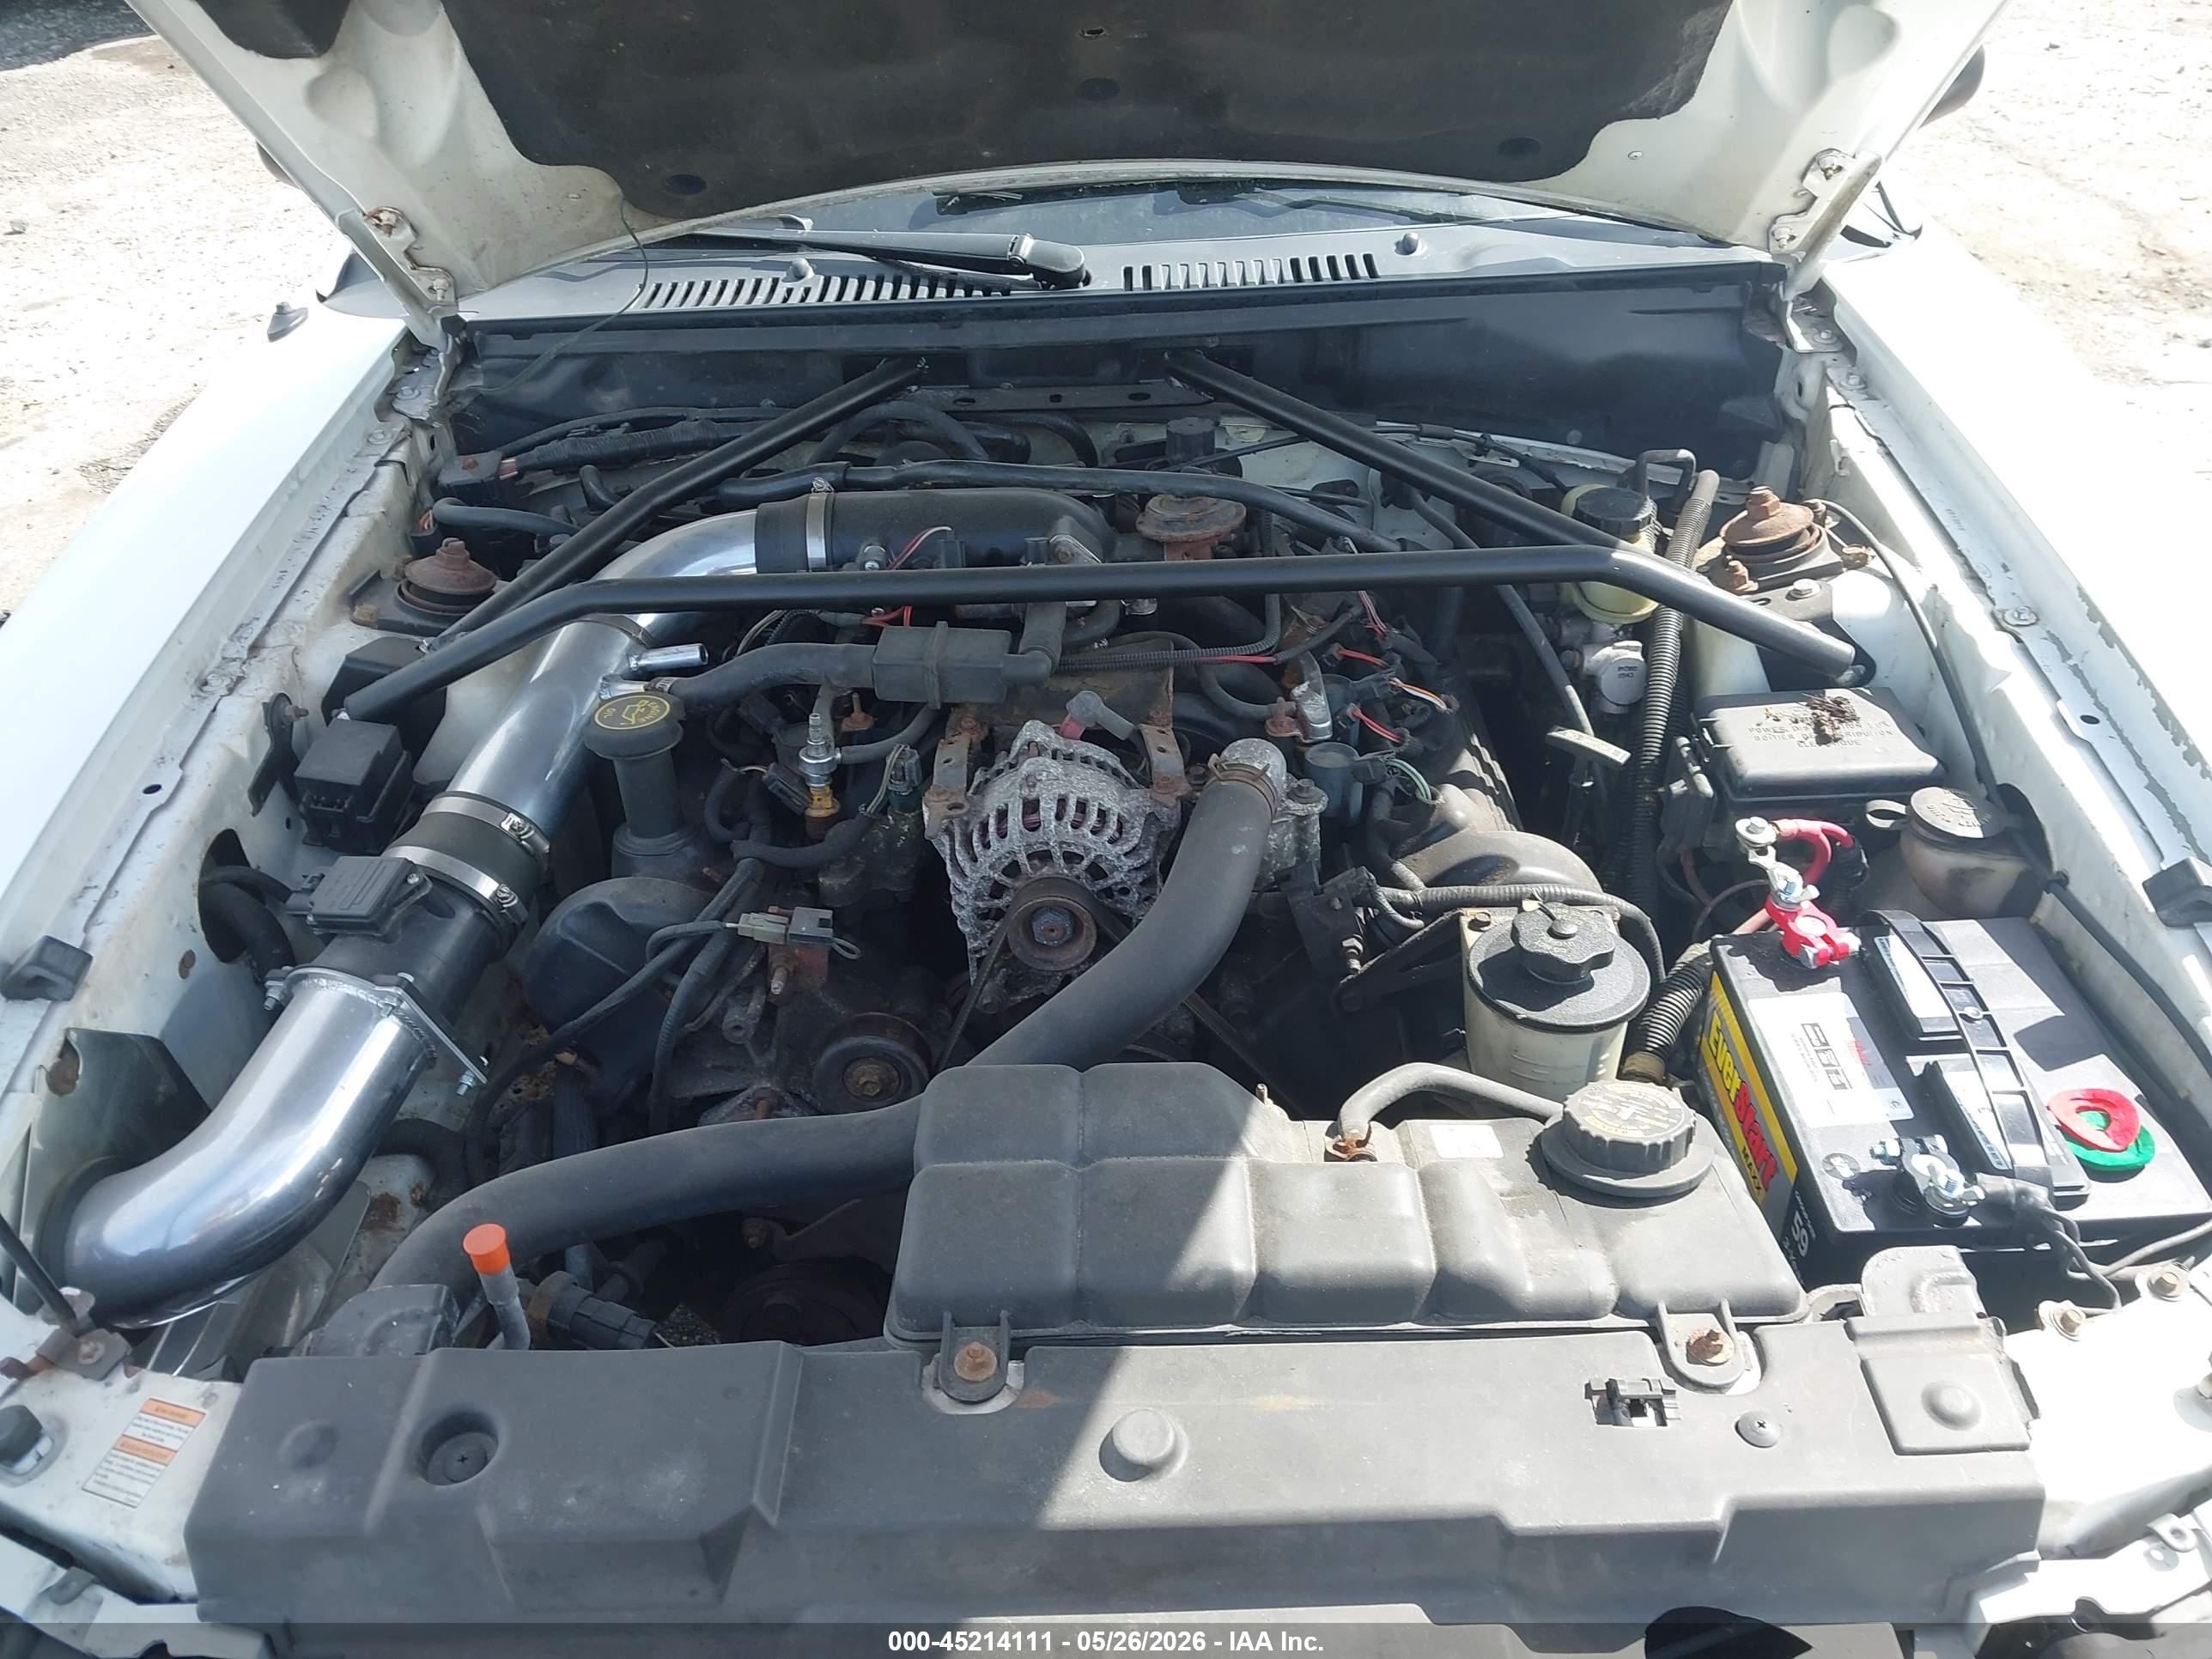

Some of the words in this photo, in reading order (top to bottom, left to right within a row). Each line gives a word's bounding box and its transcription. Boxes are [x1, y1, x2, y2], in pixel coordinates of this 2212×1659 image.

[604, 708, 617, 719] OIL
[1709, 1010, 1778, 1192] EverStart
[1791, 1211, 1809, 1257] 59
